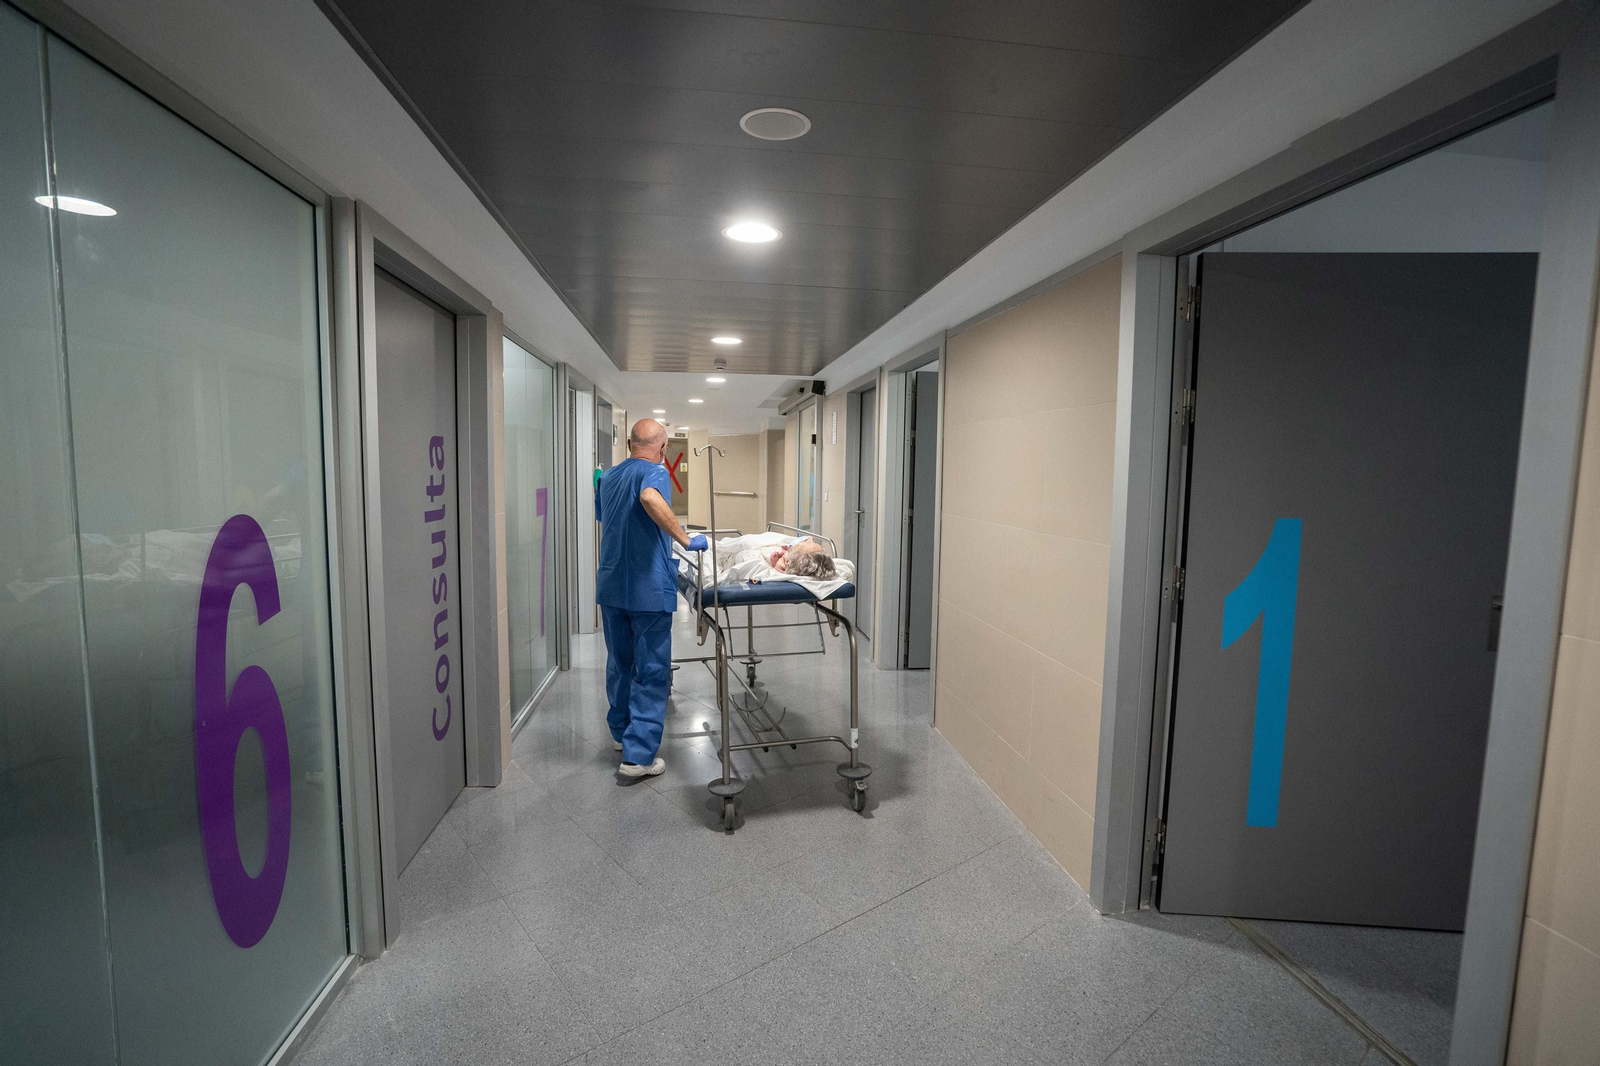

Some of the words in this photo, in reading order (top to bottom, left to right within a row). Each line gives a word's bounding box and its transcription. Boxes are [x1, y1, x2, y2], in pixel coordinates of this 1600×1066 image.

[195, 514, 292, 949] 6
[425, 435, 451, 742] Consulta
[1221, 518, 1303, 828] 1
